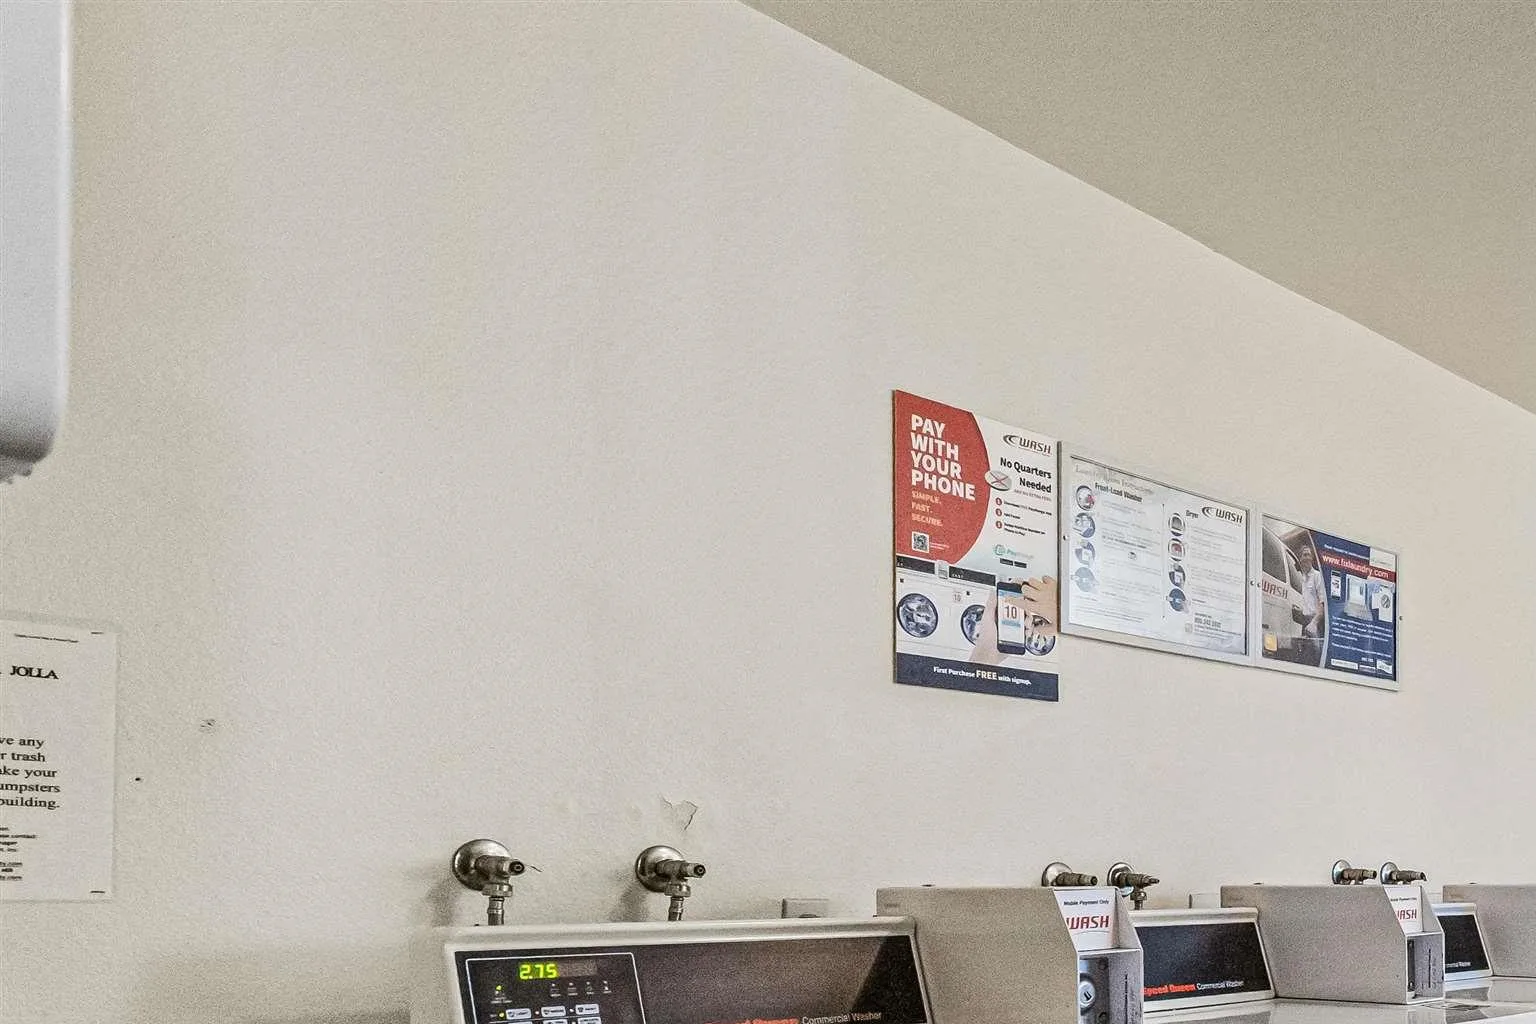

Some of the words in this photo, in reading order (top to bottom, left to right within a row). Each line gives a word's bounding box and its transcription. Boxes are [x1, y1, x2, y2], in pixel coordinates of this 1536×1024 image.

[911, 413, 946, 438] PAY
[910, 431, 959, 461] WITH
[1019, 437, 1052, 454] WASH
[910, 450, 962, 480] YOUR
[1000, 457, 1012, 469] No
[1013, 461, 1052, 479] Quarters
[911, 469, 976, 501] PHONE
[1019, 477, 1052, 493] Needed
[1215, 508, 1243, 523] WASH
[1262, 580, 1288, 600] WASH
[1004, 605, 1018, 619] 10
[10, 665, 60, 680] JOLLA
[975, 669, 998, 681] FREE
[19, 738, 45, 750] any
[11, 752, 46, 762] trash
[24, 769, 58, 779] your
[1397, 909, 1417, 920] ASH
[519, 962, 559, 980] 2.75
[850, 1012, 882, 1022] Washer
